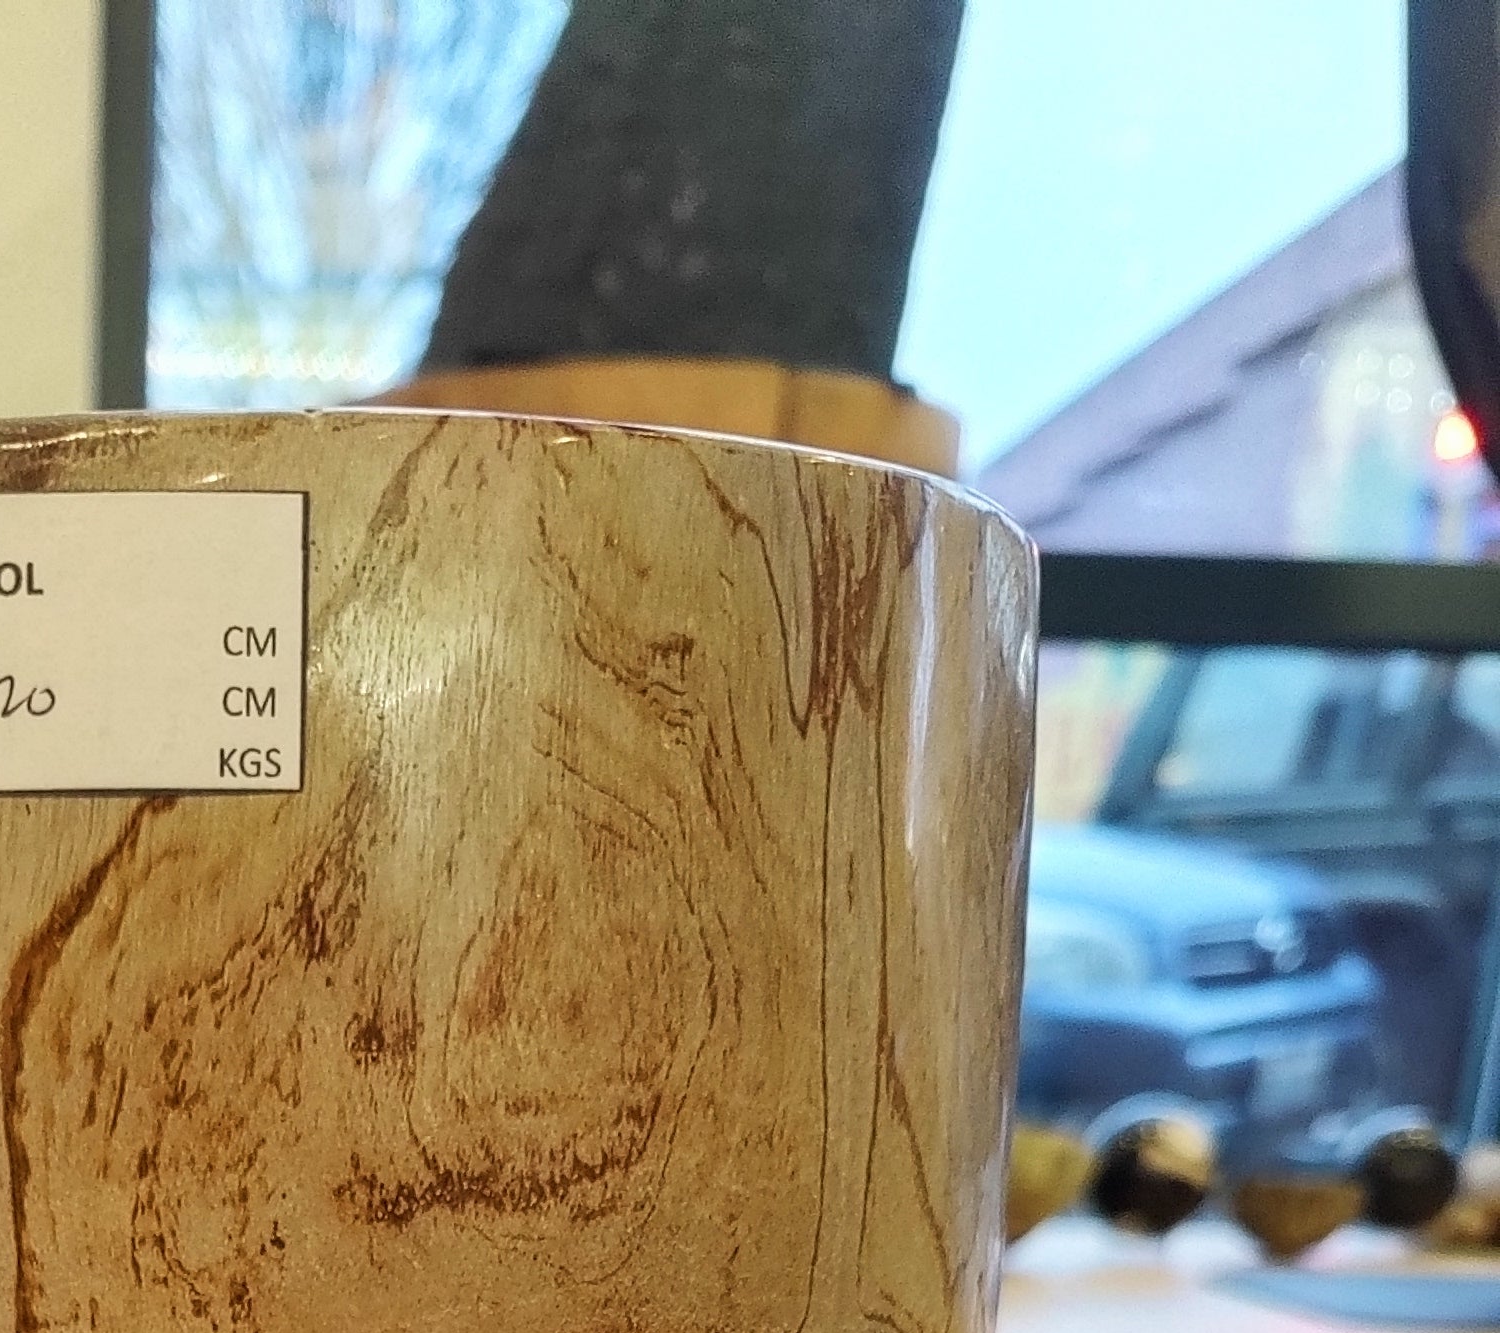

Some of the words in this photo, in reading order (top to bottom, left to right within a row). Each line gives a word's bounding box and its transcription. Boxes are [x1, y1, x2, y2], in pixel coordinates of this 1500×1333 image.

[223, 625, 276, 657] CM
[222, 686, 276, 717] CM
[219, 747, 282, 778] KGS
